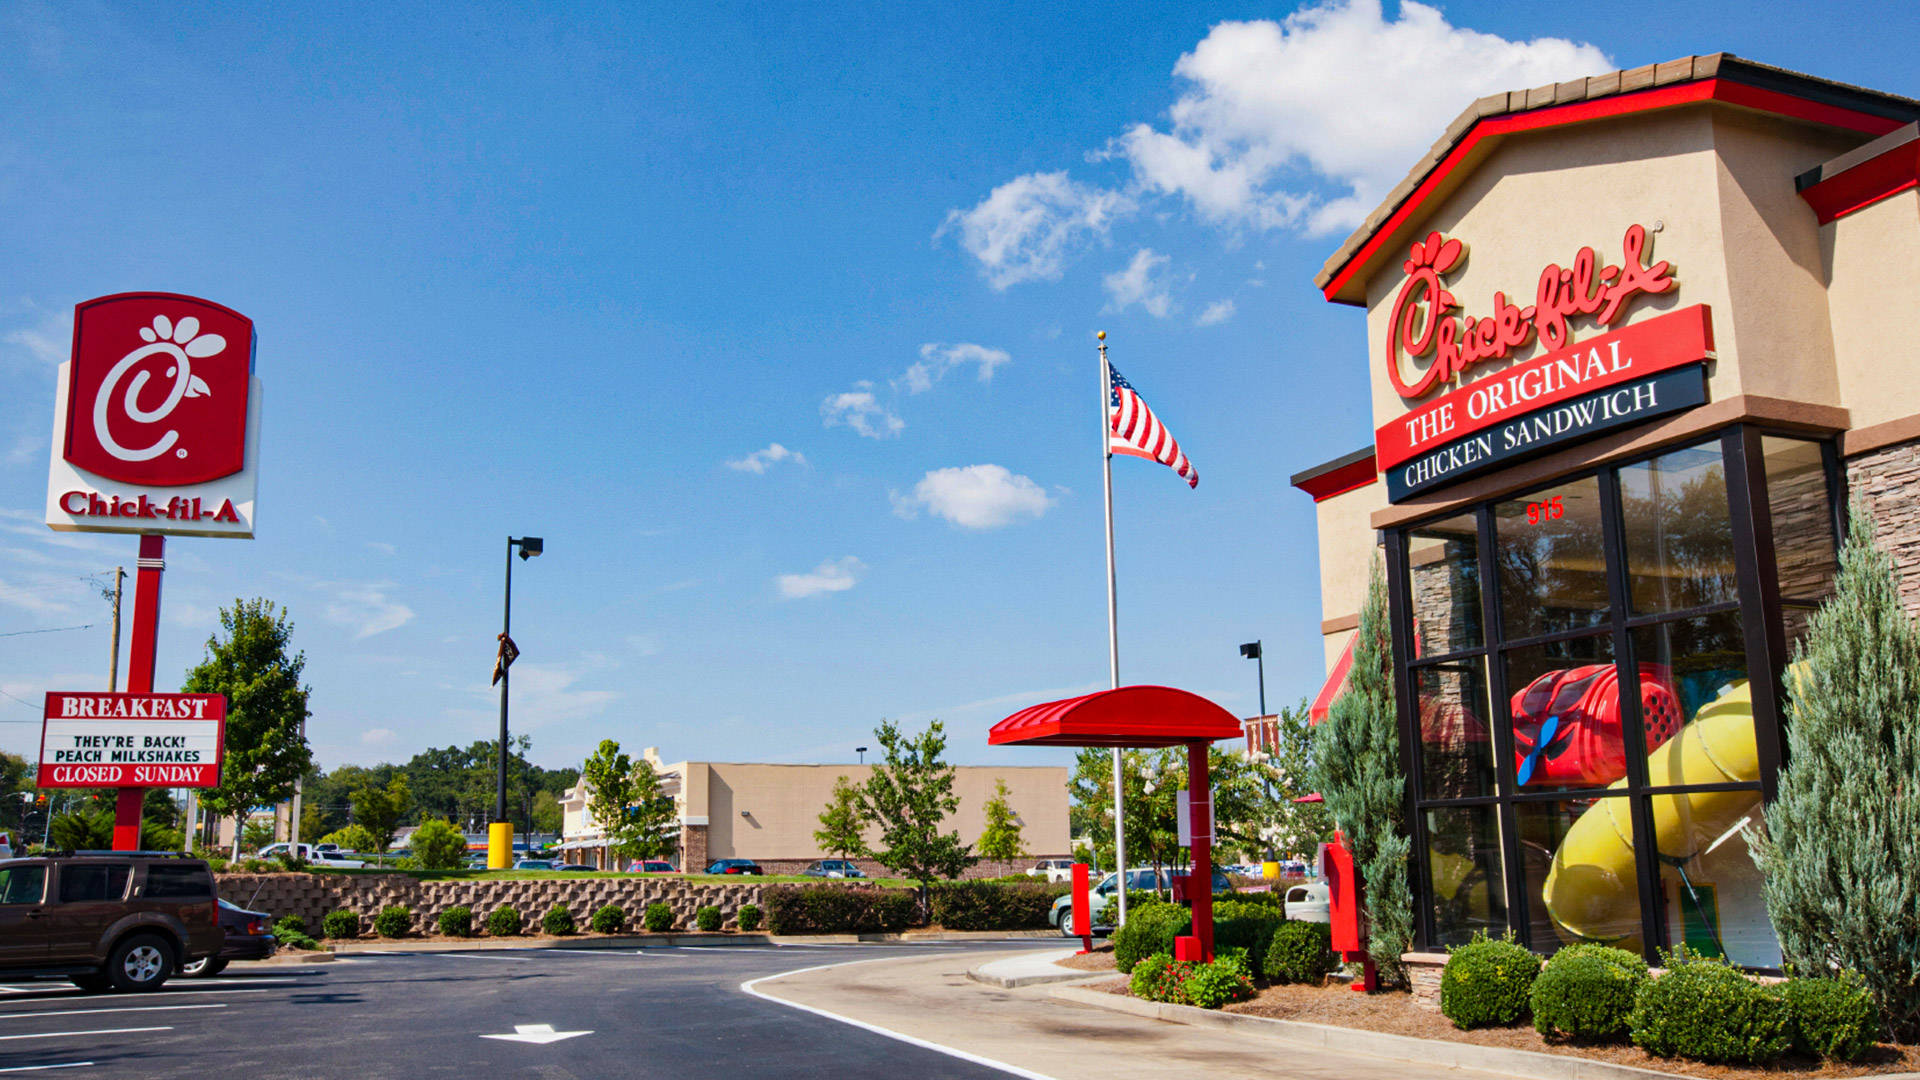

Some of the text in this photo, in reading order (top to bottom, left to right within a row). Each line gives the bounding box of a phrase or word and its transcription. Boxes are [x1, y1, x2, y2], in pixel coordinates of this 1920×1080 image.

[1386, 223, 1673, 398] Chick-fil-A
[1405, 340, 1633, 448] THE ORIGINAL
[1404, 381, 1658, 488] CHICKEN SANDWICH
[59, 491, 240, 523] Chick-fil-A
[1526, 495, 1565, 525] 915
[61, 697, 208, 719] BREAKFAST
[55, 750, 200, 762] PEACH MILKSHAKES
[74, 735, 186, 749] THEY'RE BACK!
[53, 766, 204, 783] CLOSED SUNDAY
